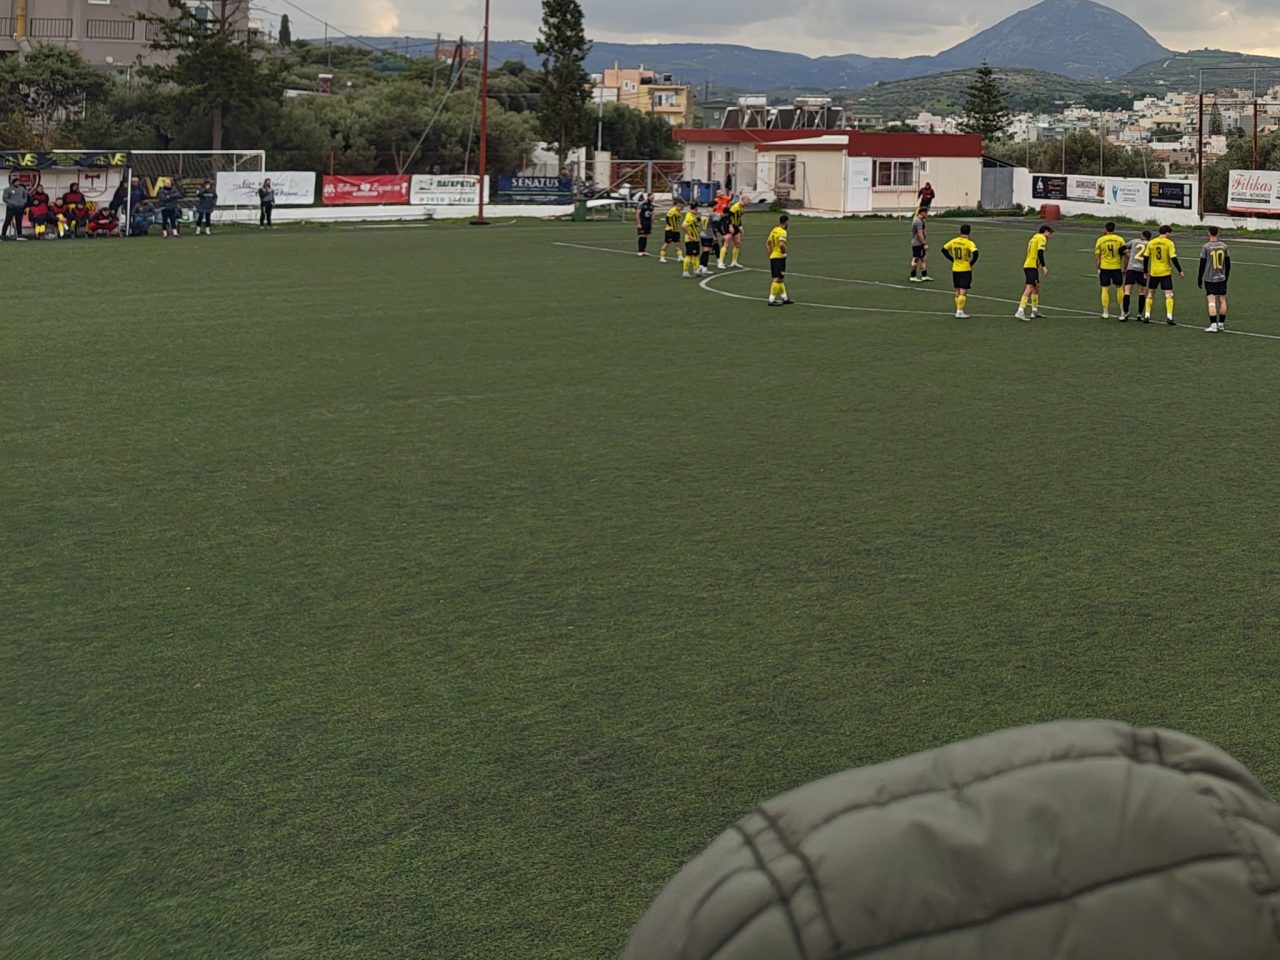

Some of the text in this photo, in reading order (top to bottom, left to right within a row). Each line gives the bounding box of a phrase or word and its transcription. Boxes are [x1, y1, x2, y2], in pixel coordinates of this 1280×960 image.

[511, 177, 559, 188] SENATUS
[1231, 173, 1272, 192] Filikas
[953, 247, 962, 260] 10
[1107, 244, 1114, 258] 4
[1155, 246, 1162, 261] 3
[1210, 249, 1225, 270] 10
